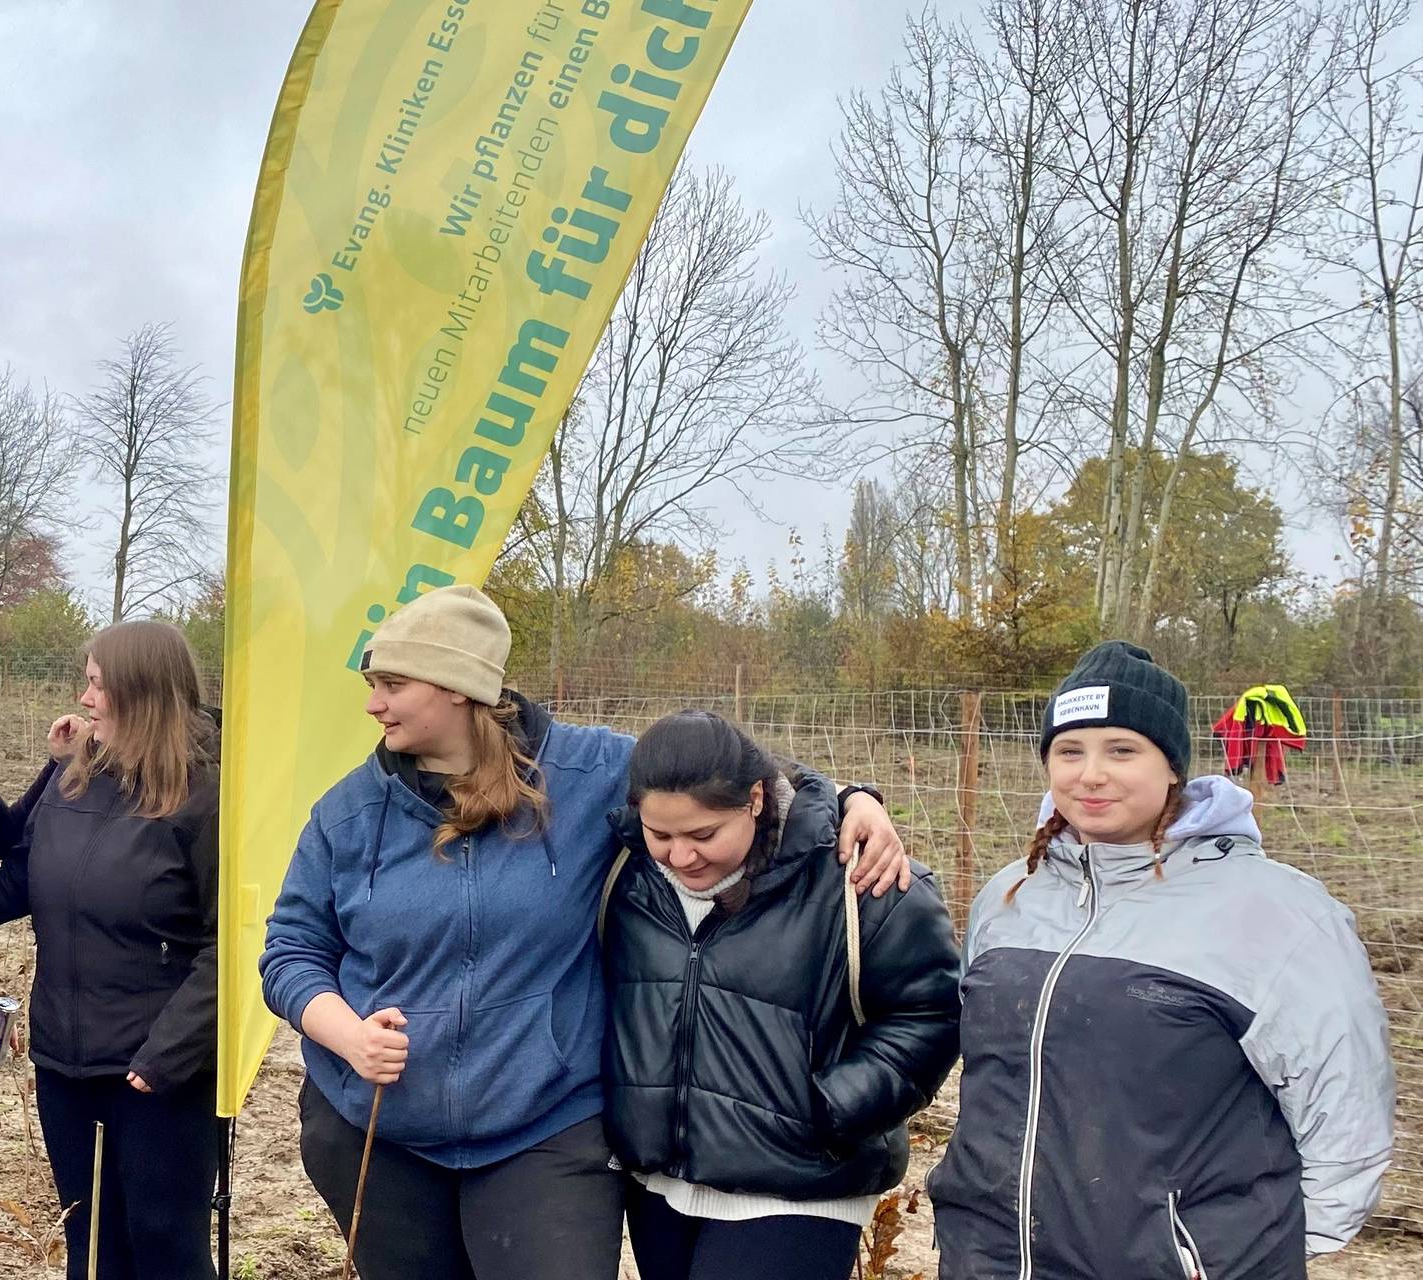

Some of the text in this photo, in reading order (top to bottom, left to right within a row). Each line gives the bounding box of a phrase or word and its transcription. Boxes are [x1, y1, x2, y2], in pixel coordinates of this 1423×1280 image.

[331, 184, 392, 272] Evang.
[375, 60, 441, 175] Kliniken
[403, 345, 455, 435] neuen
[440, 115, 559, 341] Mitarbeitenden
[548, 28, 598, 110] einen
[439, 0, 565, 238] Wir pflanzen für
[411, 318, 571, 550] Baum
[525, 165, 633, 301] für
